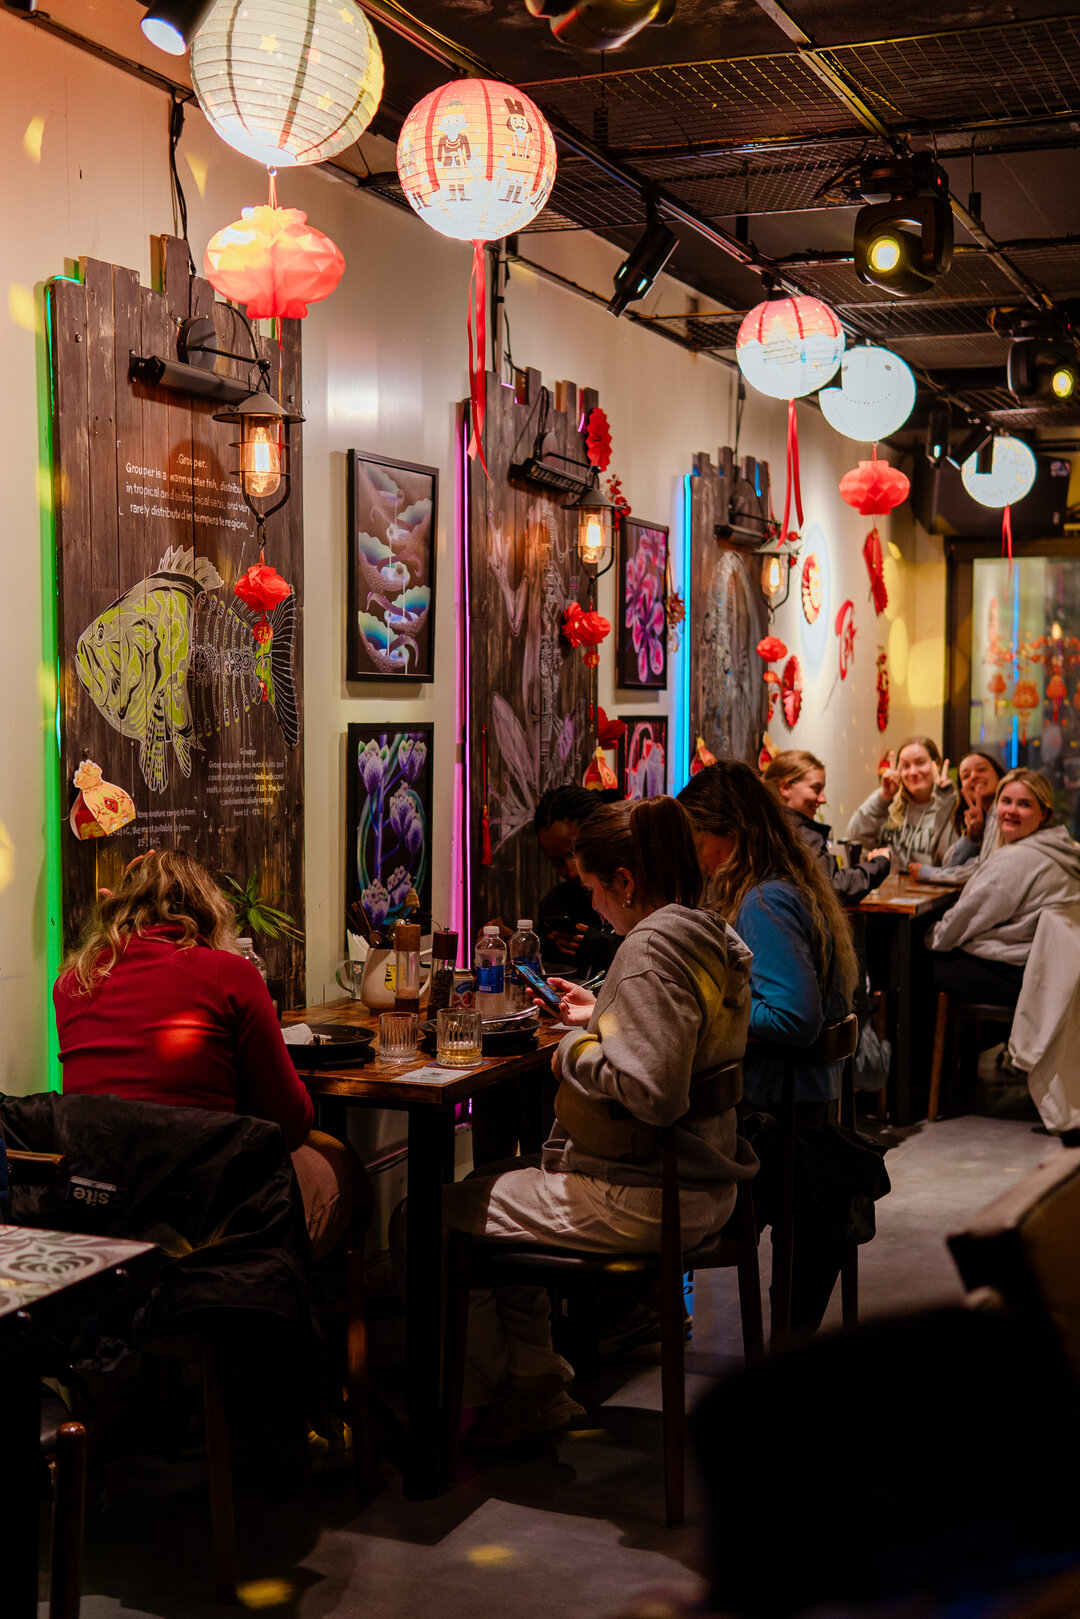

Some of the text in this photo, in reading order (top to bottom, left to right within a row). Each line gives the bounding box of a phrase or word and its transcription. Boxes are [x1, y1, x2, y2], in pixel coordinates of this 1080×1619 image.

[126, 462, 155, 479] Grouper
[155, 468, 162, 479] is
[162, 471, 167, 481] a
[169, 473, 187, 484] warm
[187, 474, 206, 487] water
[126, 481, 134, 494] in
[134, 482, 159, 499] tropical
[160, 488, 174, 500] and
[175, 489, 210, 507] subtropical
[226, 500, 238, 511] and
[238, 502, 251, 516] very
[130, 503, 249, 531] rarely distributed in temperate regions.
[73, 1186, 110, 1206] site
